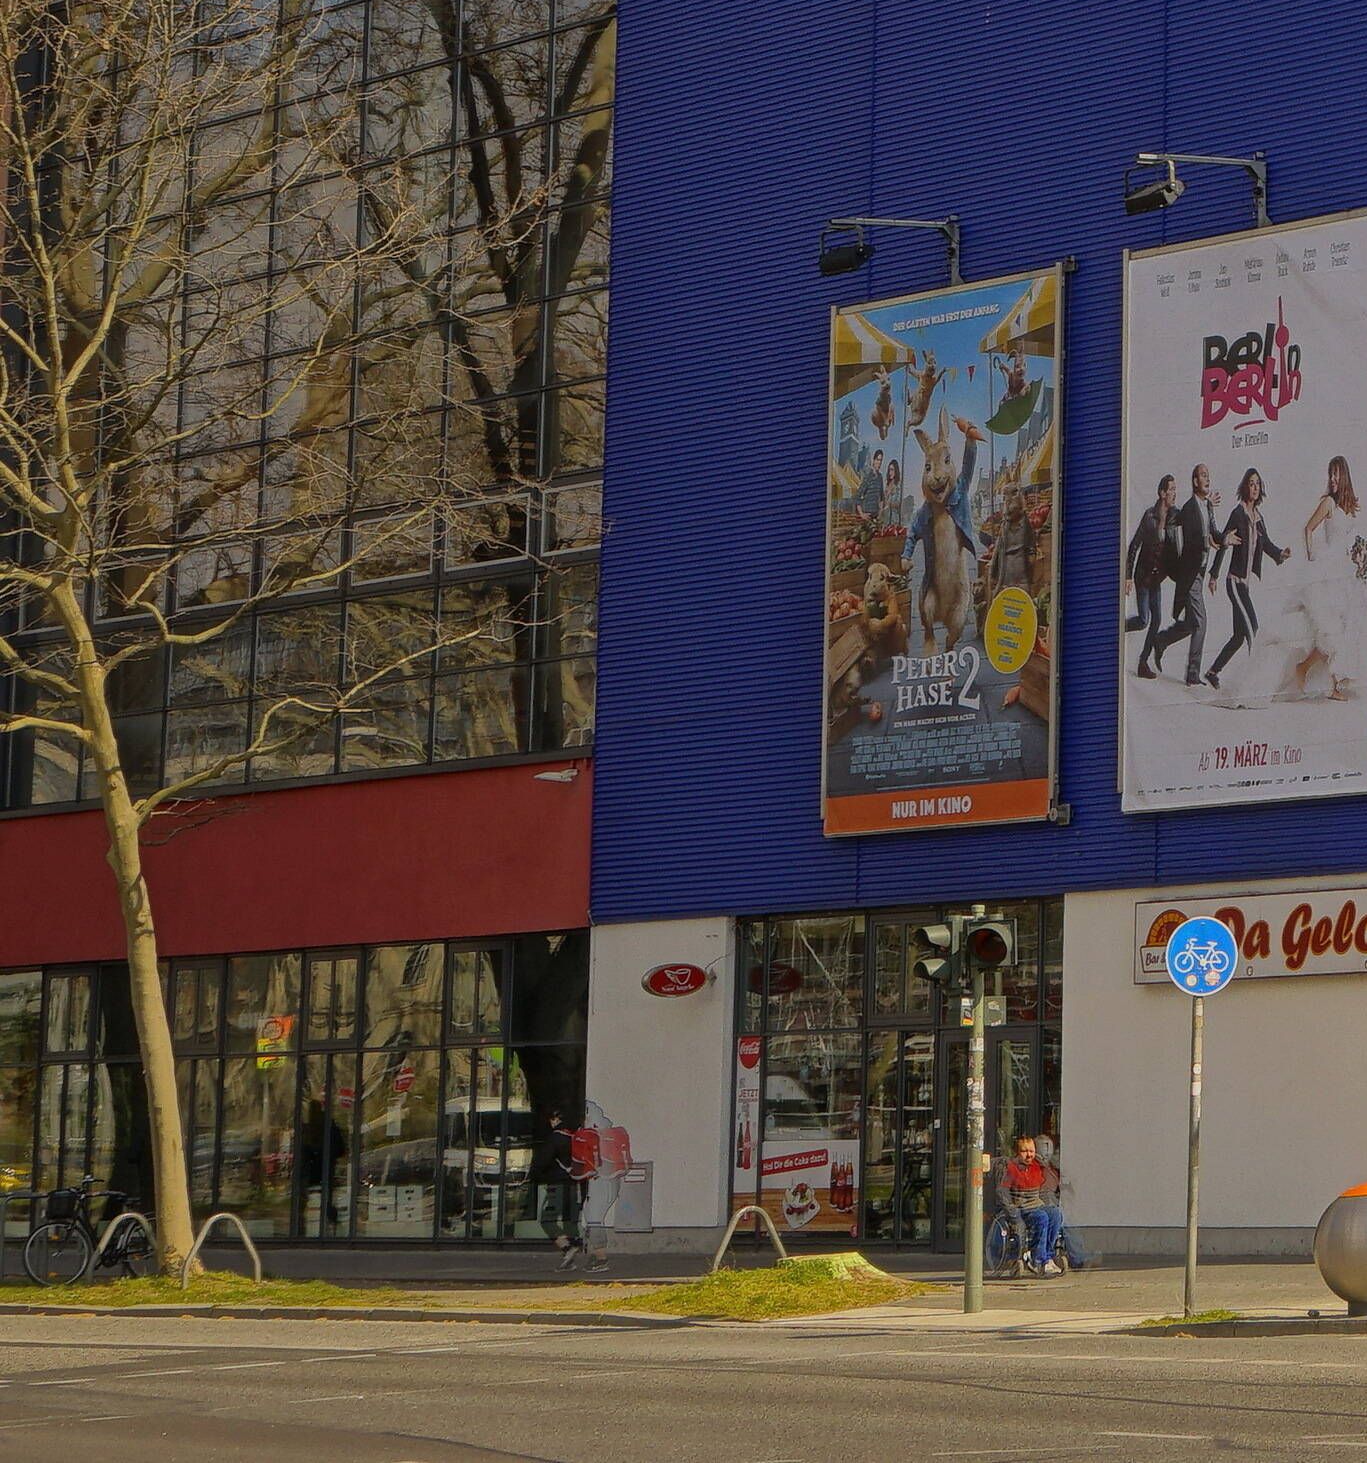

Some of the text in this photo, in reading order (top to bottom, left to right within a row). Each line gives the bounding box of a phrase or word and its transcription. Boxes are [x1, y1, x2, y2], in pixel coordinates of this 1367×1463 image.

[890, 650, 960, 684] PETER
[896, 646, 981, 713] HASE 2
[1215, 747, 1230, 769] 19.
[1233, 740, 1268, 768] MÄRZ
[891, 795, 972, 819] NUR IM KINO
[774, 1161, 783, 1169] Dir
[783, 1159, 794, 1167] die
